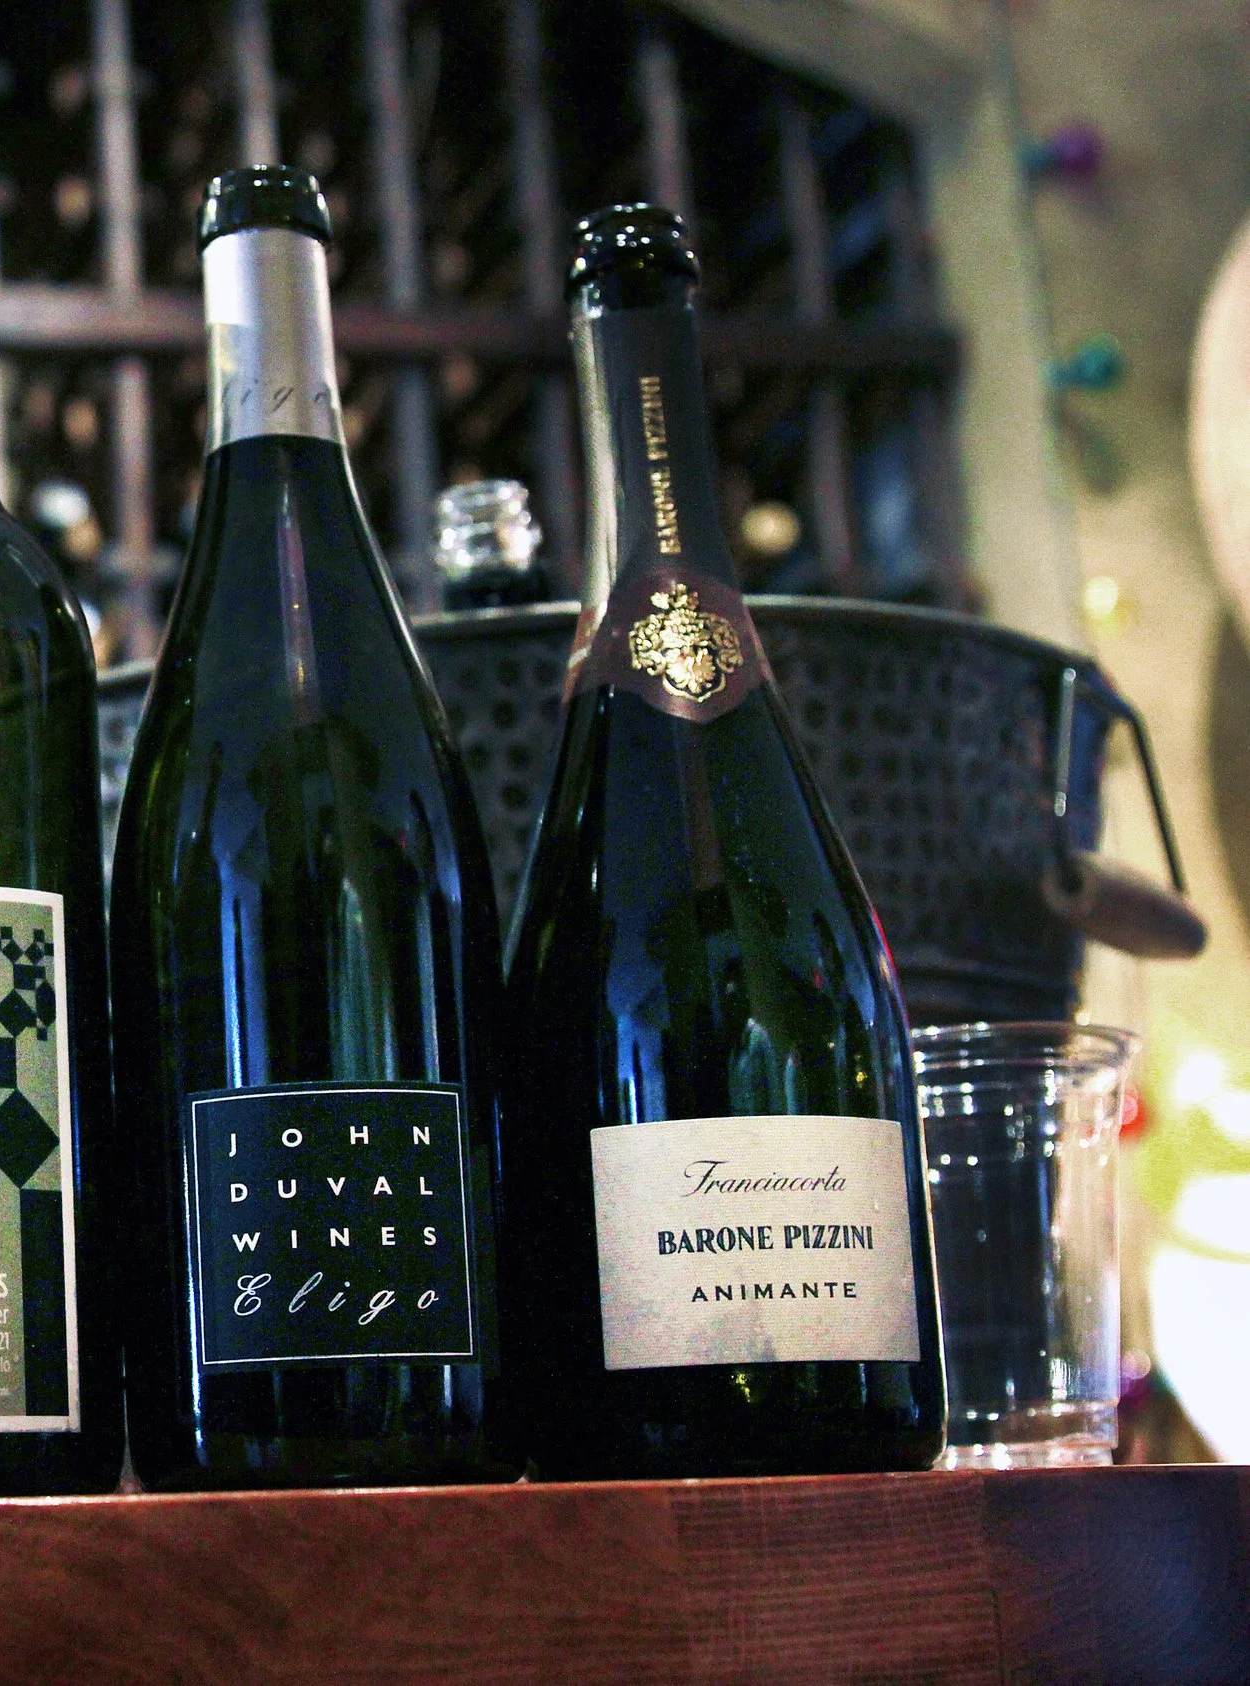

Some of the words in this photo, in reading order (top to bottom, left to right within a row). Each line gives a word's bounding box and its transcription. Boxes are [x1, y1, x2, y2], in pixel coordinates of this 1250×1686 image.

[680, 1160, 848, 1198] Franciacorta
[657, 1225, 773, 1256] BARONE
[784, 1225, 874, 1250] PIZZINI
[691, 1282, 857, 1302] ANIMANTE
